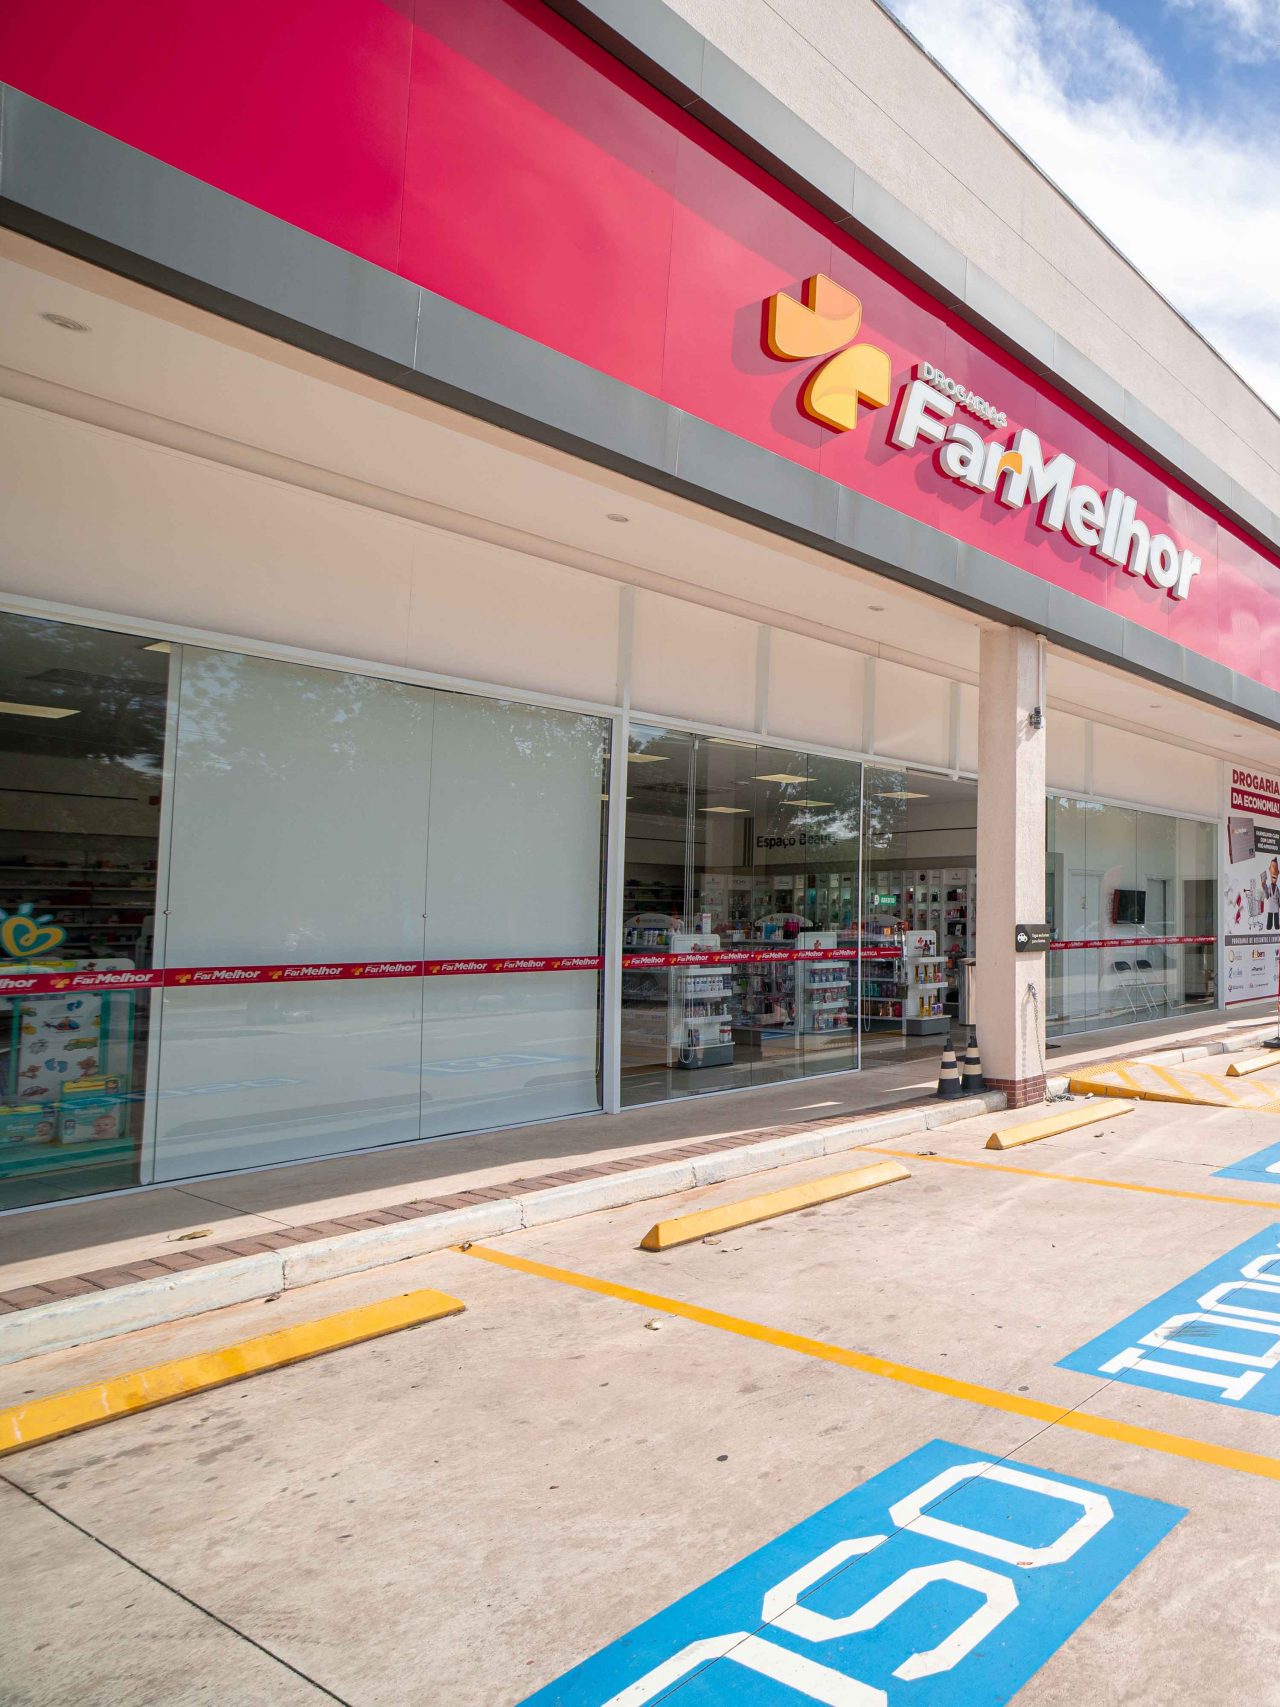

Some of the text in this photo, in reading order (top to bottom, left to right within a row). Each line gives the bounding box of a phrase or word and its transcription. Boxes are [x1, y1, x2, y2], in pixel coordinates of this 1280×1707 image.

[917, 361, 1008, 429] DROGARIAS
[890, 379, 1202, 601] FarMelhor
[1232, 768, 1280, 796] DROGARIA
[1232, 792, 1280, 814] DA ECONOMIA!
[756, 835, 796, 850] Espaço
[0, 957, 600, 990] lhor FarMelhor FarMelhor FarMelhor FarMelhor FarMelhor FarMelhor FarMelhor
[631, 956, 666, 965] FarMelhor
[600, 1461, 1116, 1707] SO
